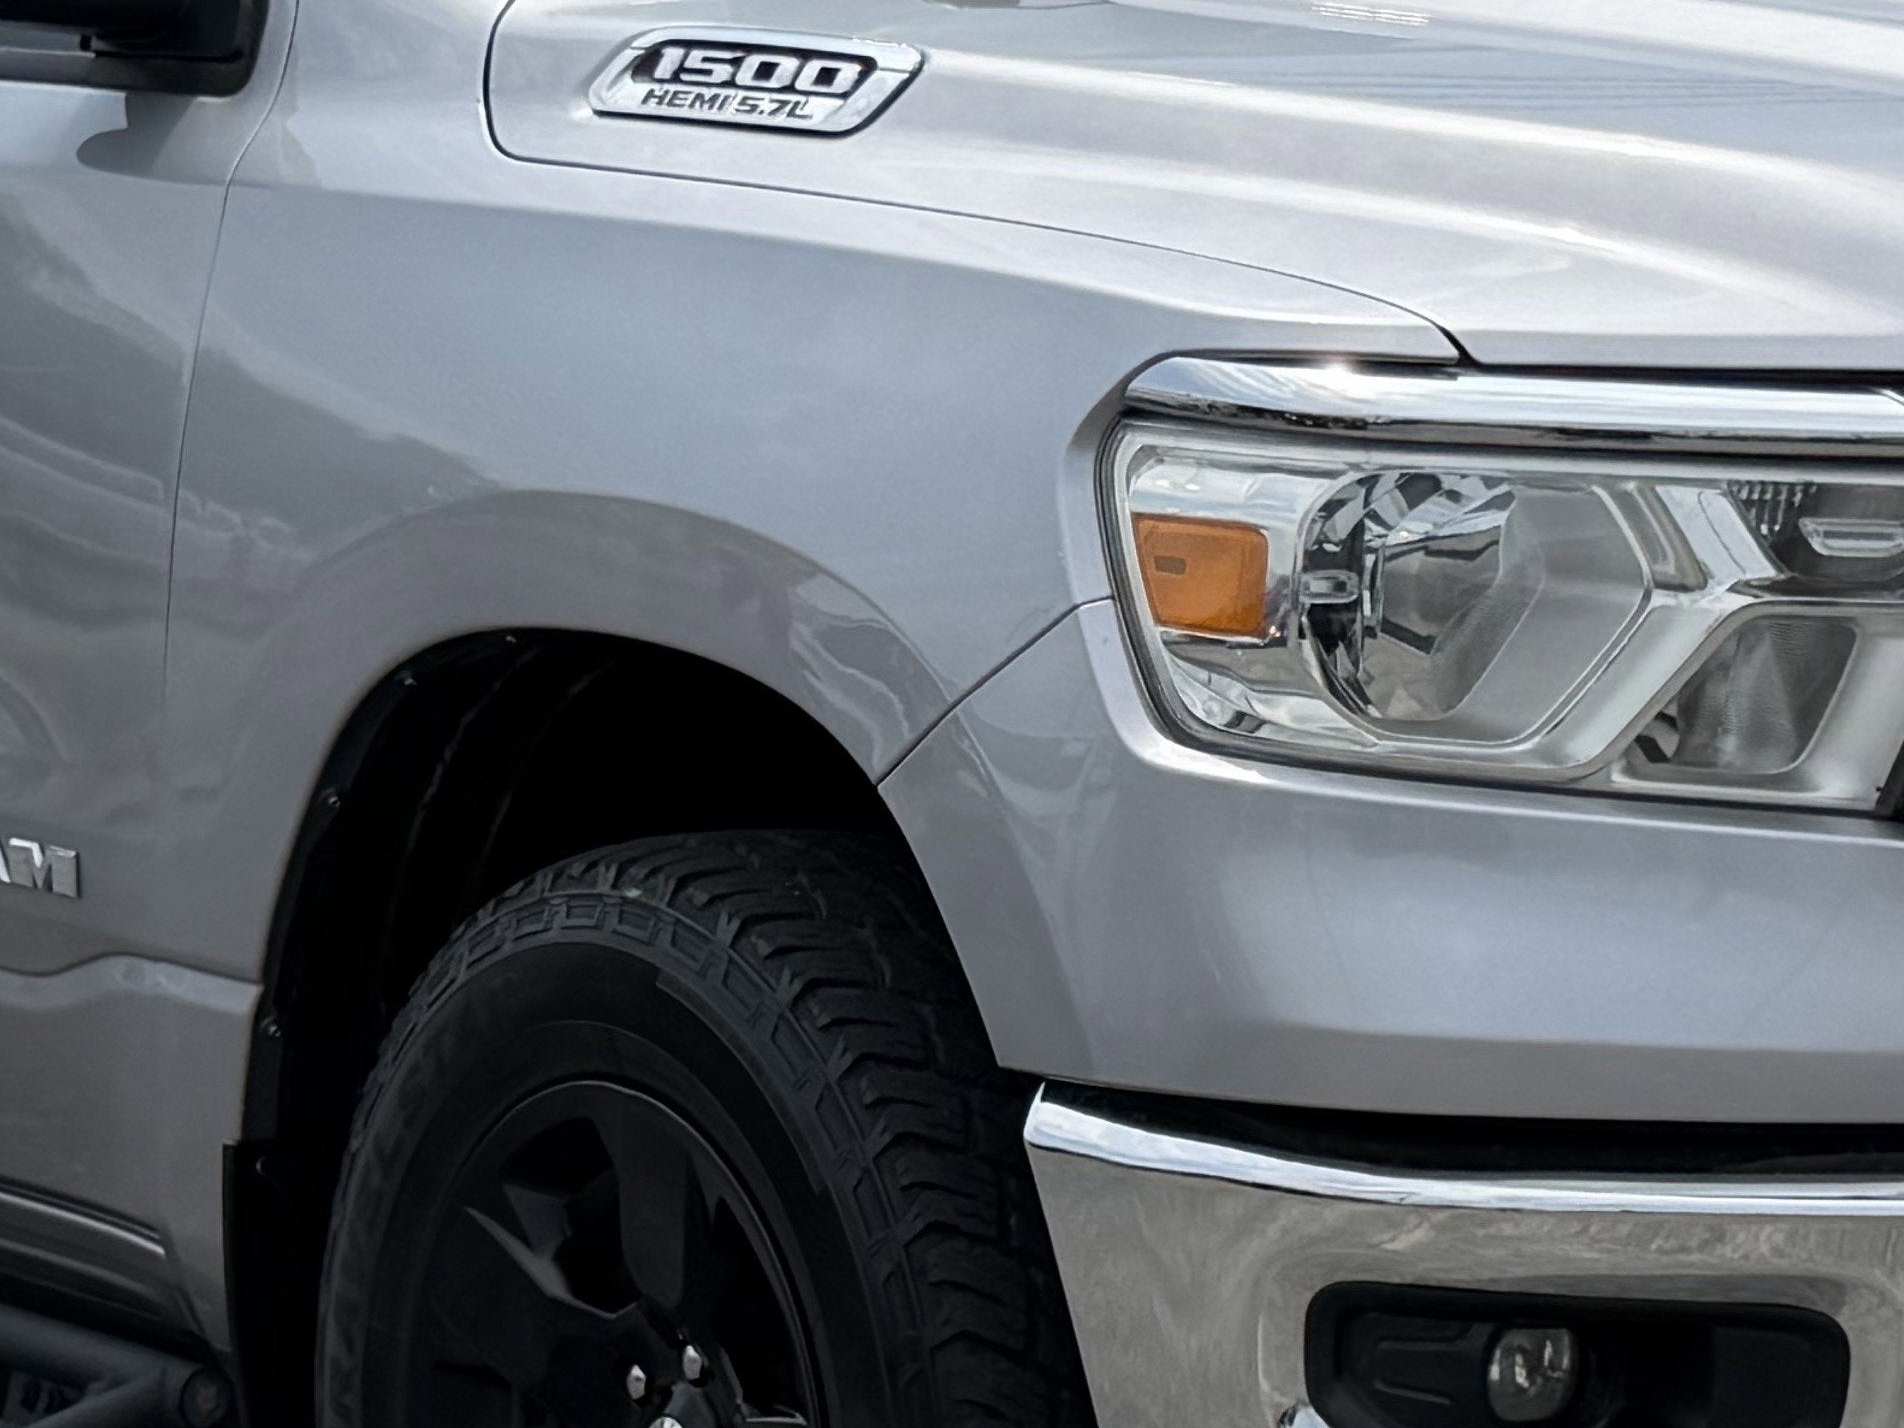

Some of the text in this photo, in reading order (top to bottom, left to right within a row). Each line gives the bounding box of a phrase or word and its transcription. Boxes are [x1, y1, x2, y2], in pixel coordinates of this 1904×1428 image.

[651, 45, 863, 95] 1500
[640, 87, 815, 120] HEMI 5.7L
